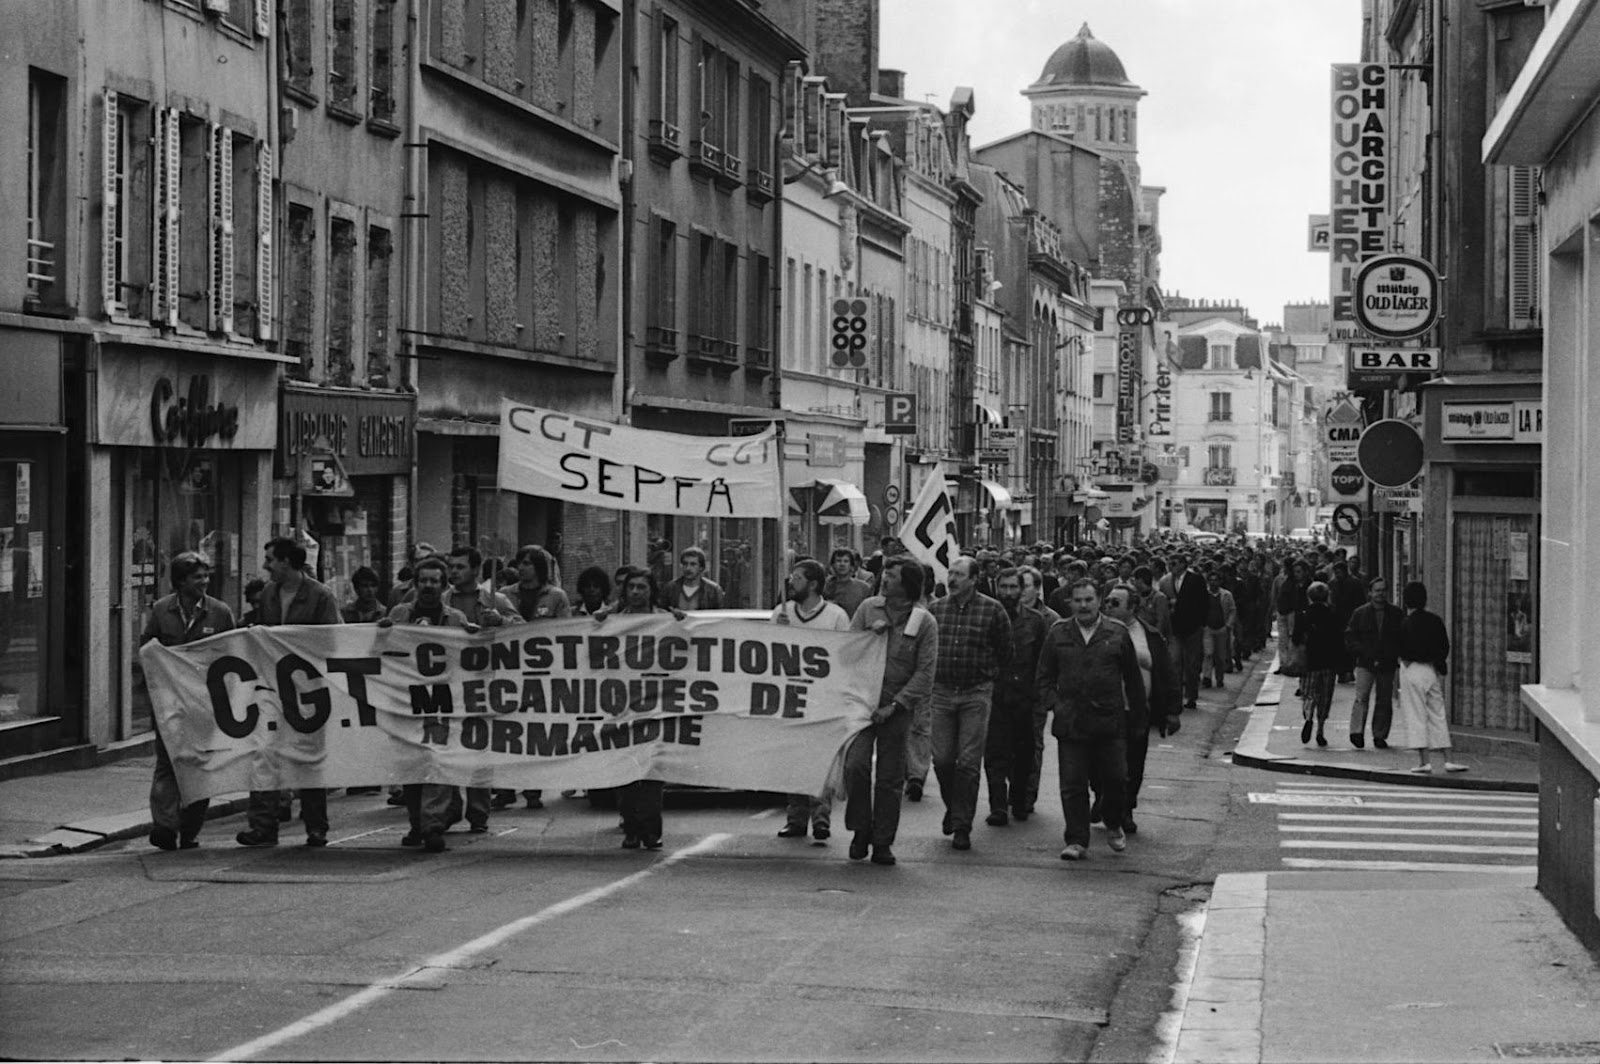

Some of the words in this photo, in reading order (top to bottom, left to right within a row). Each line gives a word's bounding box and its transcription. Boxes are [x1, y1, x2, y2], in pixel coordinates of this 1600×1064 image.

[1333, 66, 1361, 321] BOUCHERIE
[1366, 294, 1391, 310] OLD
[1392, 294, 1428, 310] LAGER
[1361, 353, 1431, 368] BAR
[892, 397, 911, 421] P
[1519, 409, 1531, 432] LA
[508, 406, 612, 450] CGT
[1329, 428, 1360, 441] CMA
[706, 433, 777, 466] CGT
[559, 453, 733, 514] SEPFA
[1332, 475, 1363, 484] TOPY
[416, 635, 831, 678] CONSTRUCTIONS
[408, 678, 719, 716] MECANIQUES
[750, 682, 808, 719] DE
[421, 714, 703, 757] NORMANDIE
